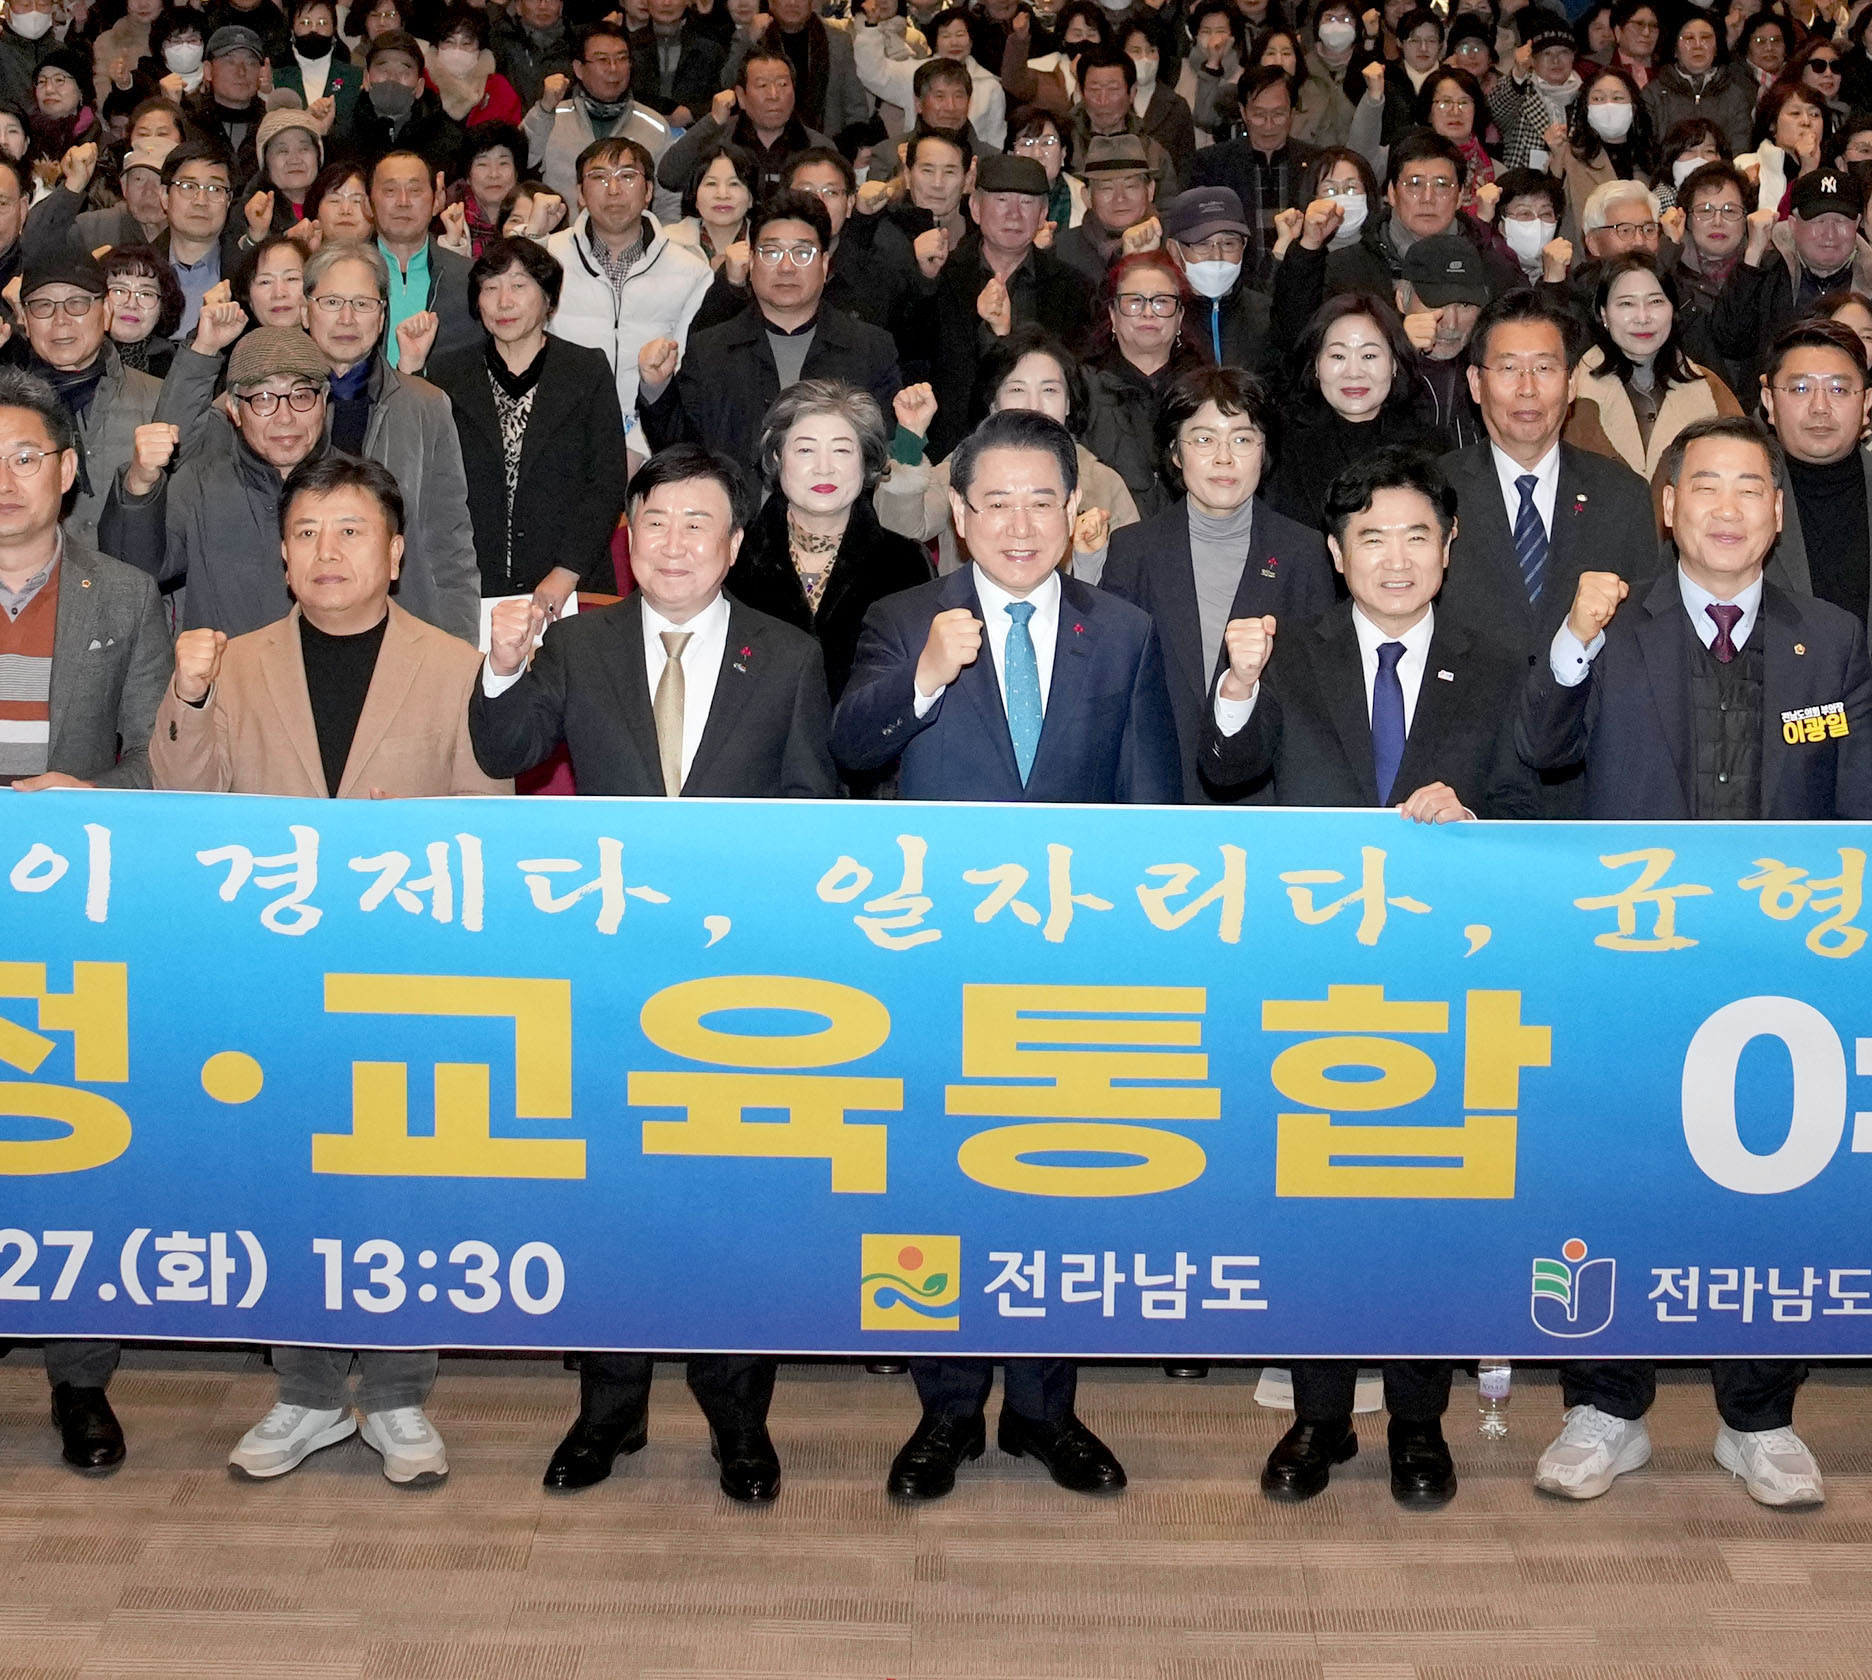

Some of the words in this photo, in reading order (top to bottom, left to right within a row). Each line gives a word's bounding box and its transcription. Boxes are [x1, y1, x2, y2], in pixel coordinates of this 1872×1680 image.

[1821, 176, 1837, 193] NY
[1782, 712, 1850, 745] 이광일
[195, 825, 732, 948] 경제다,
[815, 834, 1492, 958] 일자리다,
[312, 1238, 565, 1315] 13:30
[983, 1250, 1268, 1320] 전라남도
